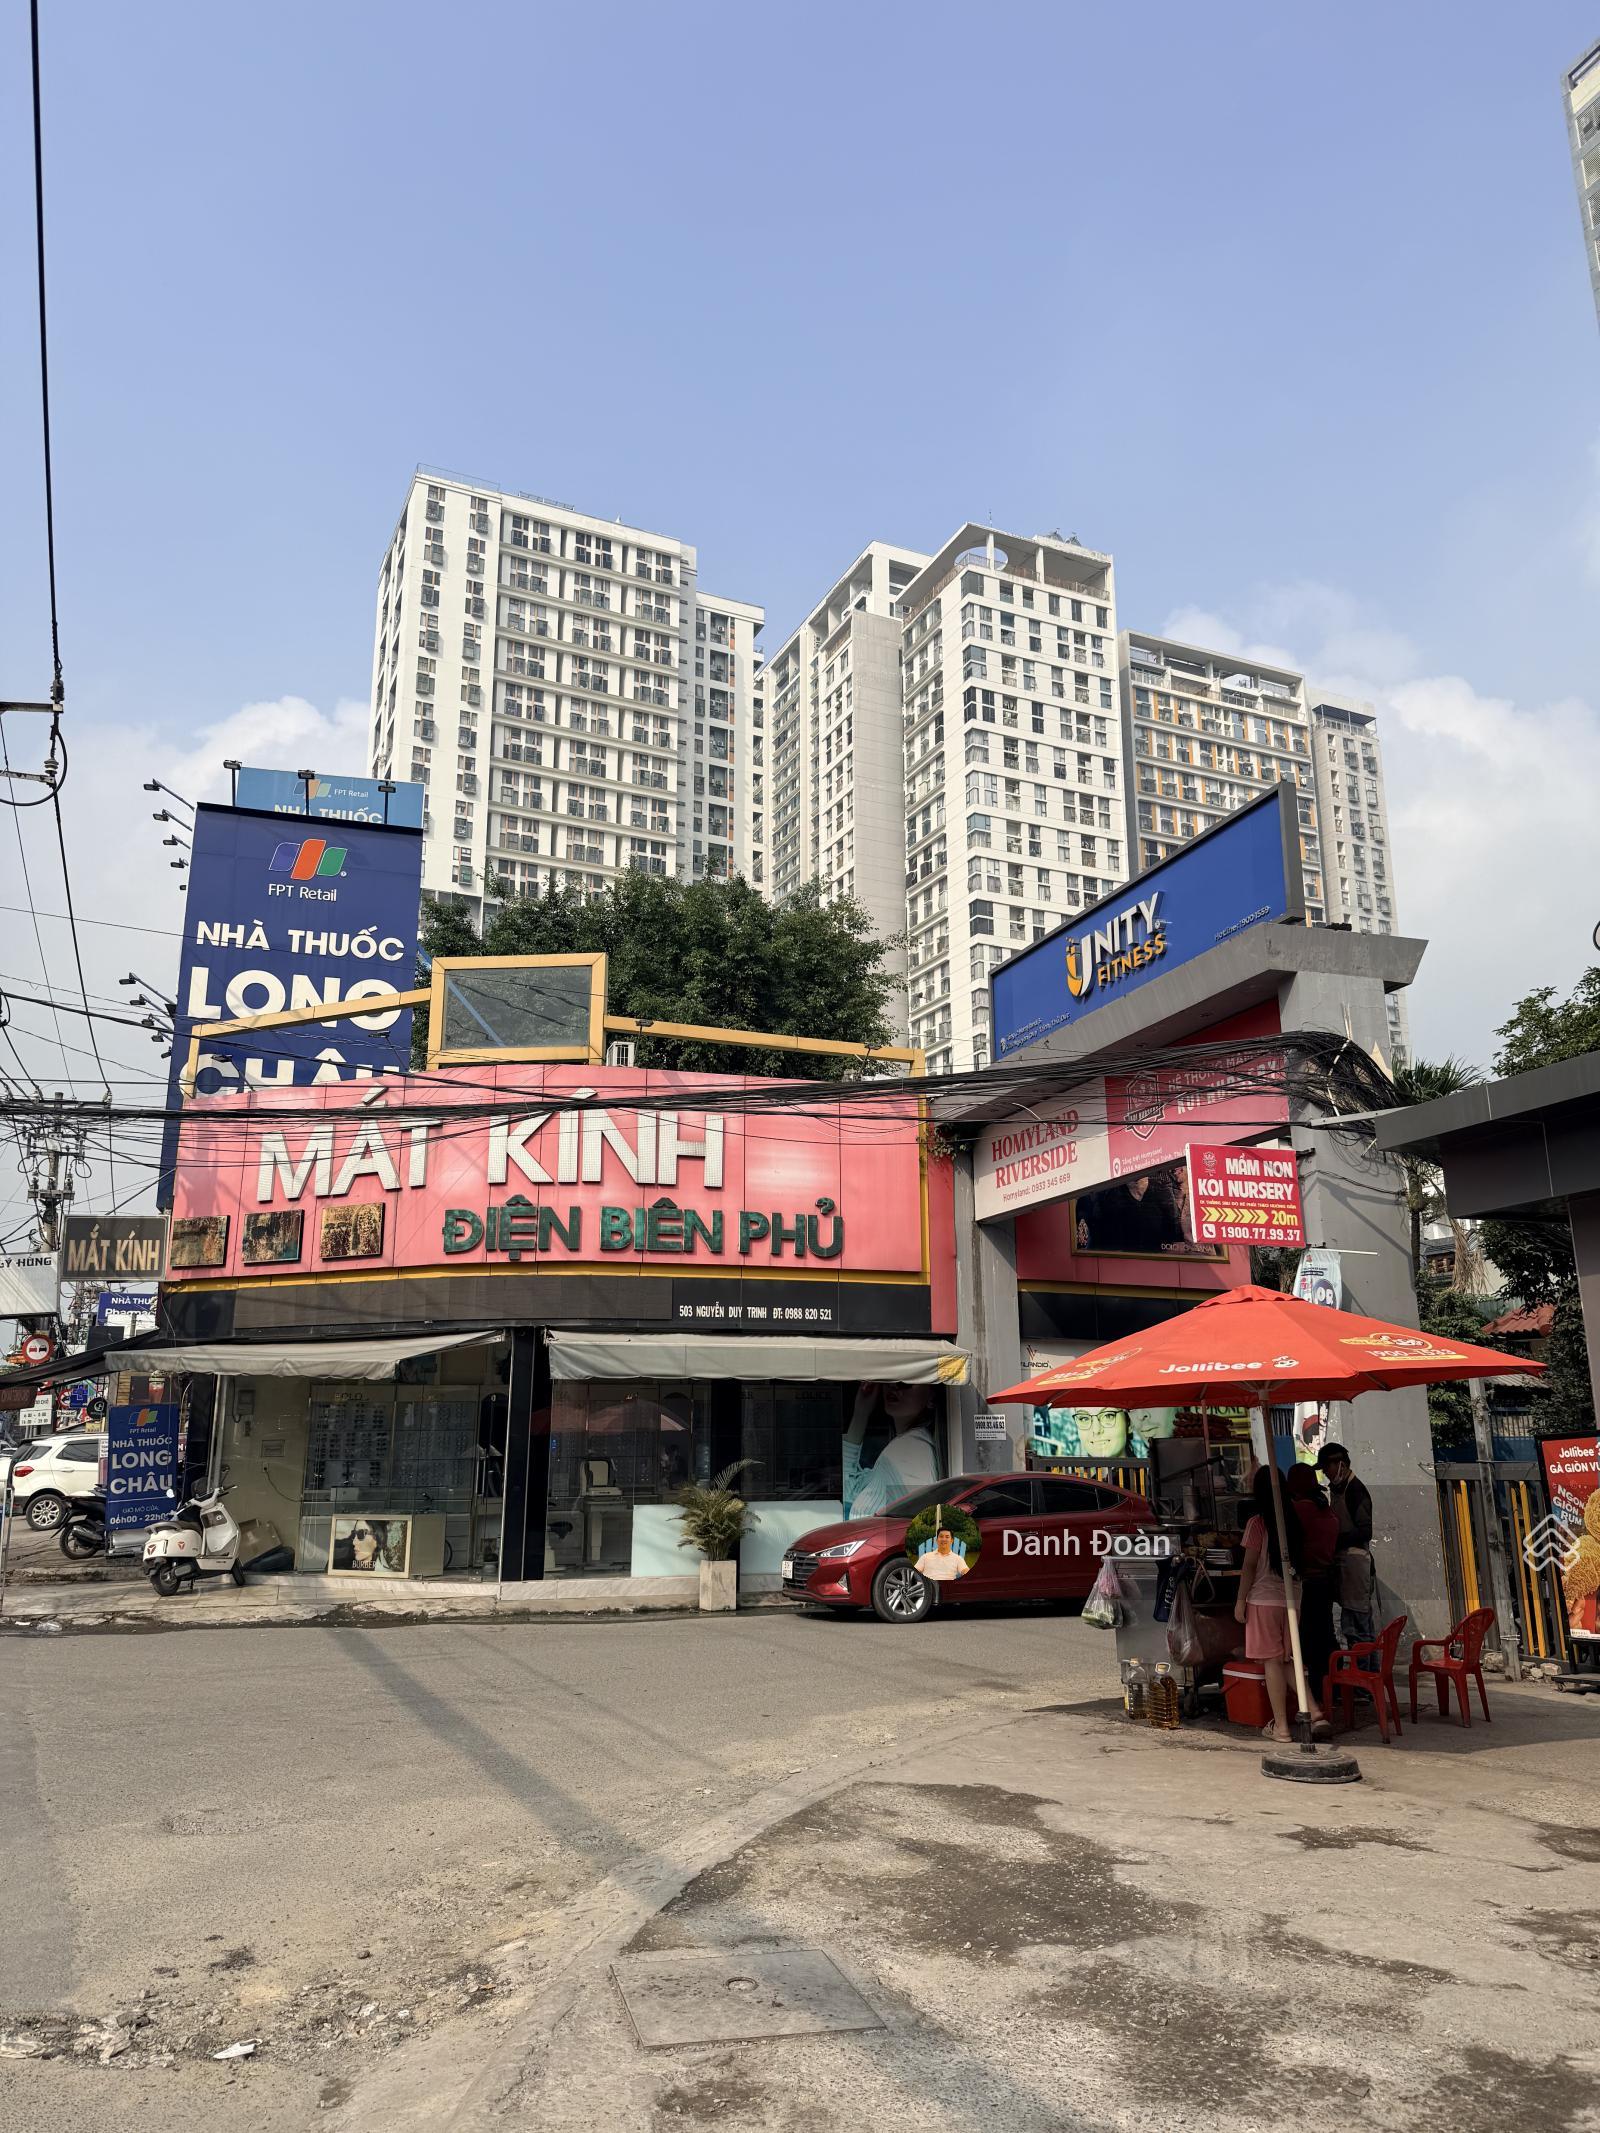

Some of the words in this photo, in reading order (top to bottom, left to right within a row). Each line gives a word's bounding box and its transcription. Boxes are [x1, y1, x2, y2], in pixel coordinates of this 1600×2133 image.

[349, 790, 368, 798] Retail
[268, 884, 294, 897] FPT
[300, 886, 337, 902] Retail
[196, 920, 270, 950] NHÀ
[288, 926, 405, 961] THUỐC
[1097, 933, 1164, 987] FITNESS
[488, 1087, 724, 1188] KÍNH
[992, 1109, 1079, 1162] HOMYLAND
[995, 1141, 1078, 1189] RIVERSIDE
[1263, 1161, 1293, 1178] NON
[1197, 1178, 1224, 1197] KOI
[1228, 1180, 1294, 1200] NURSERY
[442, 1194, 581, 1260] ĐIỆN
[600, 1197, 723, 1252] BIÊN
[738, 1198, 843, 1258] PHỦ
[1271, 1210, 1298, 1226] 20m
[1221, 1226, 1300, 1241] 1900.77.99.37
[66, 1224, 110, 1272] MẮT
[115, 1230, 161, 1271] KÍNH
[112, 1296, 131, 1305] NHÀ
[679, 1305, 693, 1317] 503
[696, 1301, 724, 1318] NGUYỄN
[728, 1306, 743, 1318] DUY
[747, 1306, 767, 1319] TRINH
[773, 1307, 783, 1319] ĐT:
[784, 1308, 803, 1320] 0988
[805, 1308, 818, 1320] 820
[820, 1309, 832, 1320] 521
[1159, 1362, 1263, 1374] Jollibee
[112, 1438, 134, 1448] NHÀ
[137, 1434, 172, 1447] THUỐC
[112, 1450, 172, 1470] LONG
[1559, 1446, 1594, 1458] Jollibee
[1550, 1461, 1564, 1474] GÀ
[1564, 1460, 1589, 1473] GIÒN
[110, 1472, 173, 1494] CHÂU
[1557, 1484, 1585, 1509] NGON
[110, 1515, 138, 1525] 06h00
[1561, 1510, 1582, 1525] RỤM
